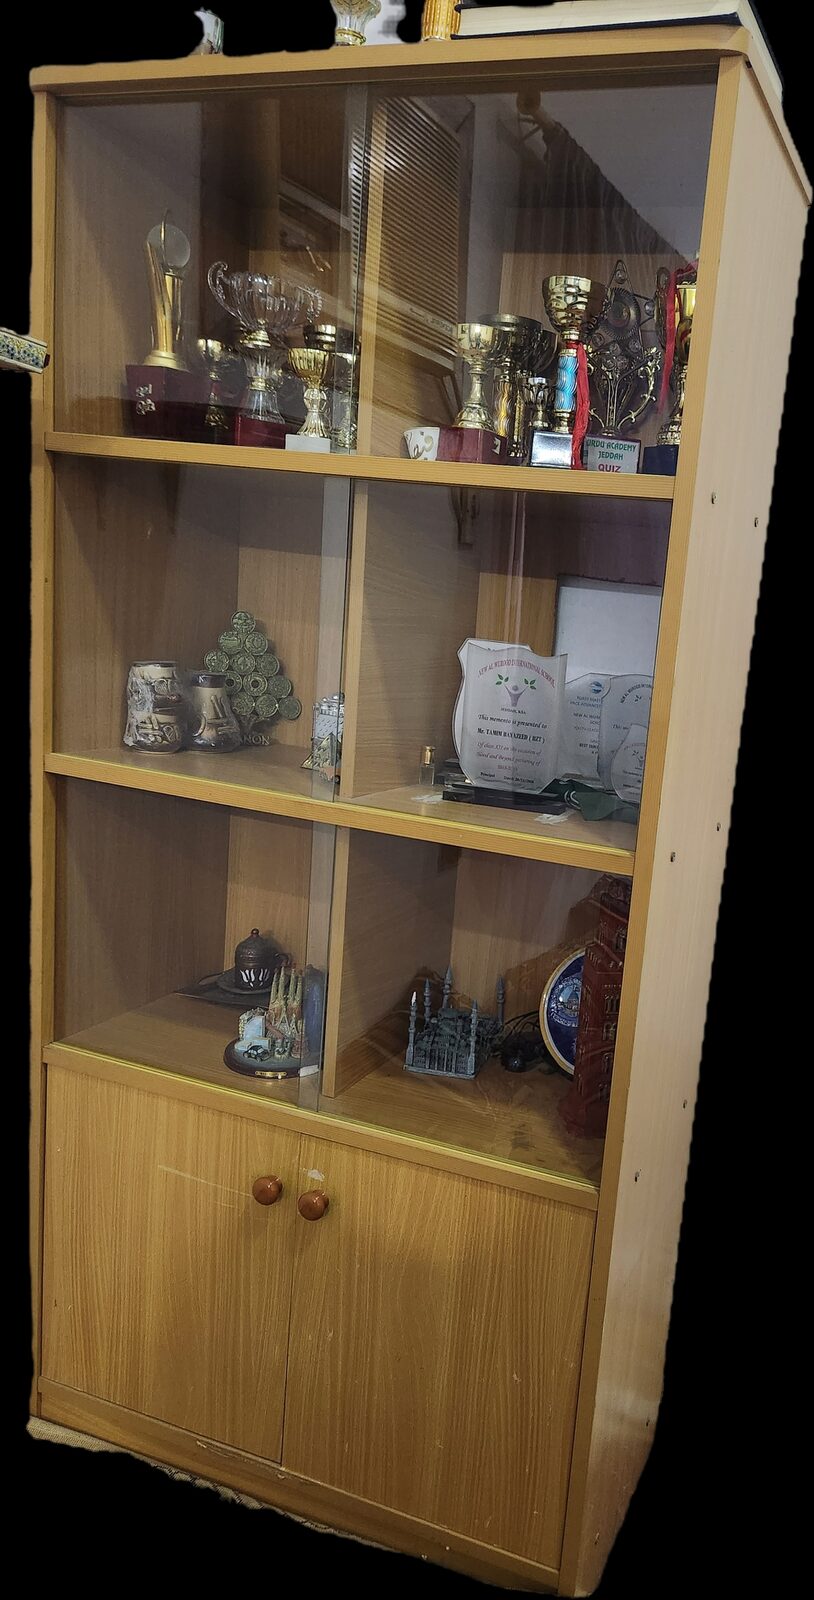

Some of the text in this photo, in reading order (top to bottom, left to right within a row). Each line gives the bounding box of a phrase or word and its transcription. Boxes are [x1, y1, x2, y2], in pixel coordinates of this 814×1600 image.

[607, 442, 636, 452] ACADEMY
[598, 451, 624, 460] JEDDAH
[598, 464, 621, 472] QUIZ
[489, 716, 512, 724] memento
[517, 720, 541, 729] presented
